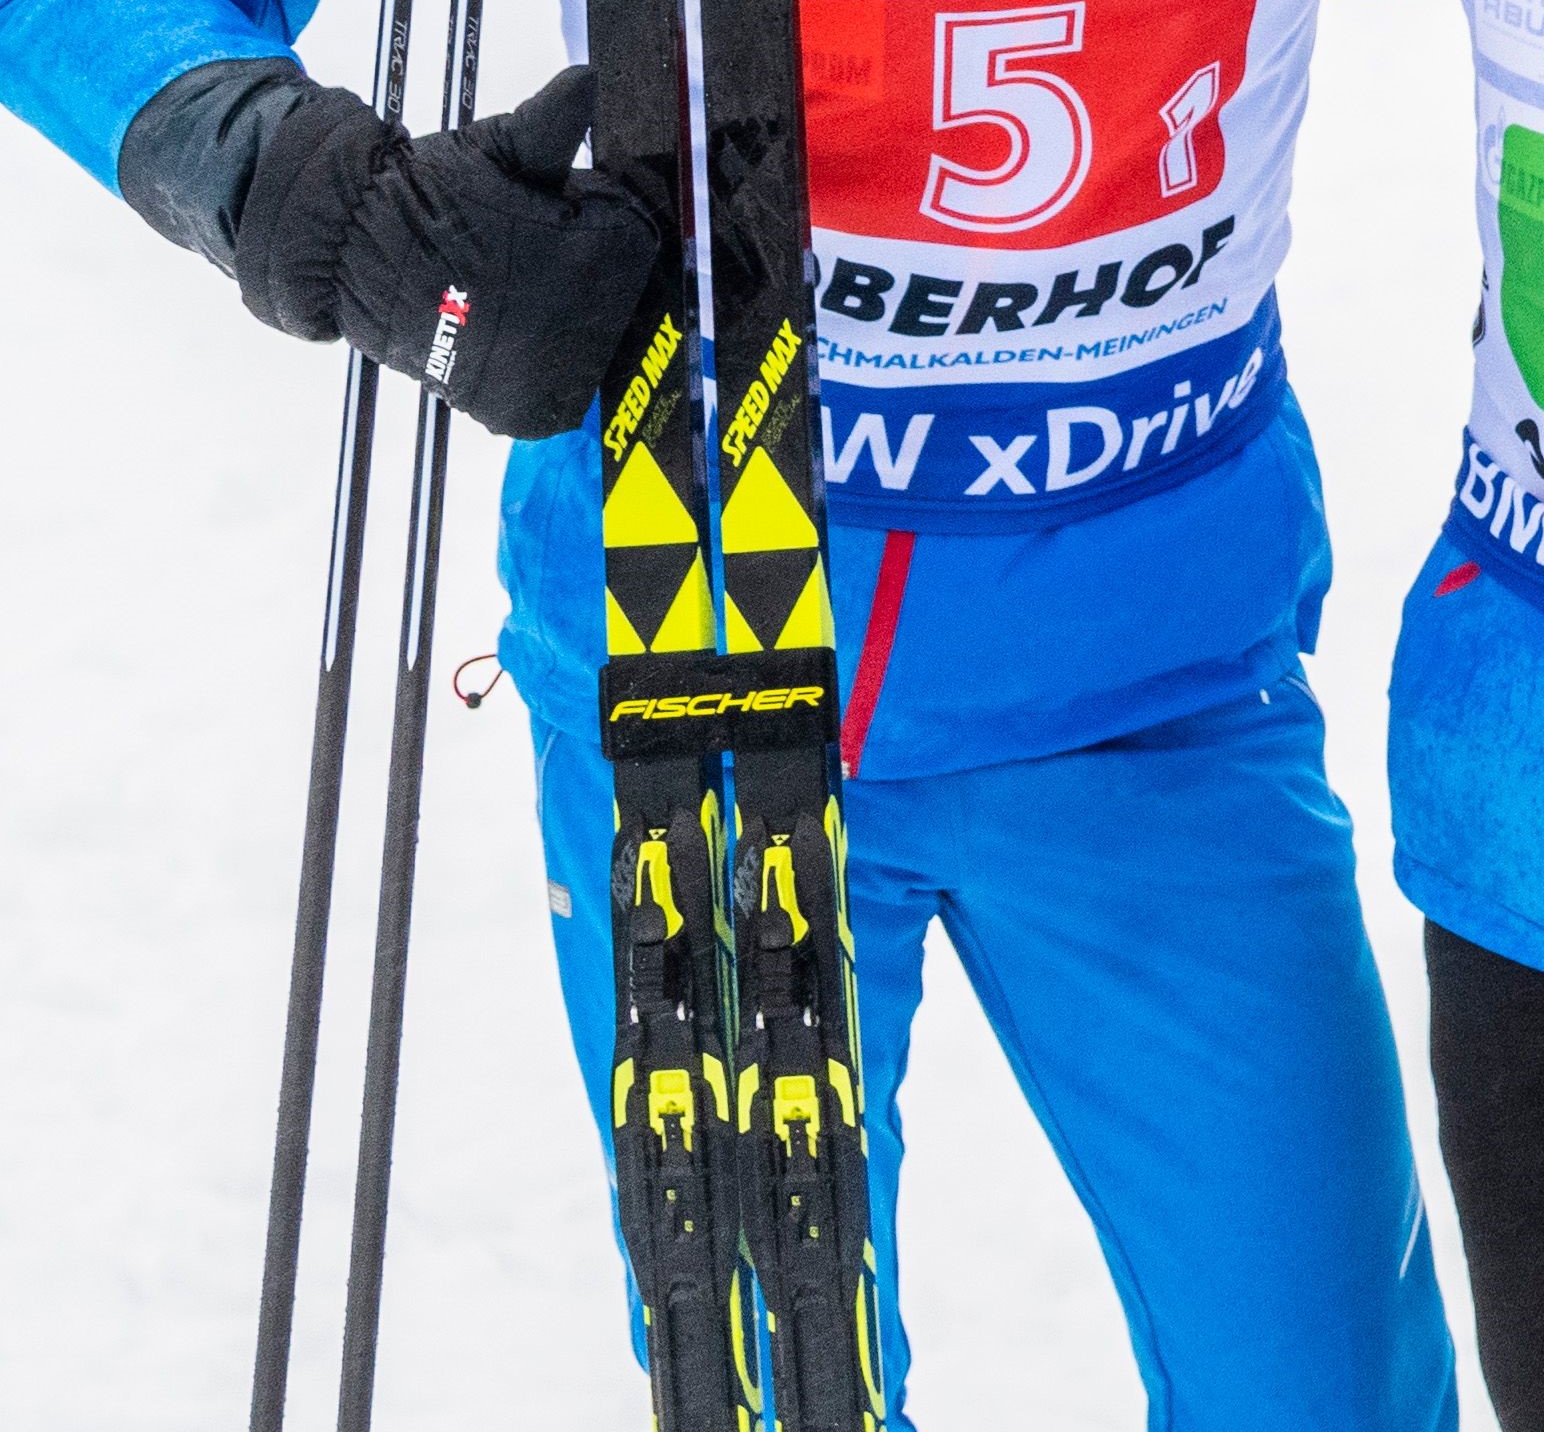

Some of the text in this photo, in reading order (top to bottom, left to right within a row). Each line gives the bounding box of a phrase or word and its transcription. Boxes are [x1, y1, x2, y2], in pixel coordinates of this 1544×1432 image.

[919, 1, 1093, 233] 5
[812, 215, 1236, 337] BERHOF
[816, 298, 1229, 368] CHMALKALDEN-MEININGEN
[603, 375, 650, 463] SPEED
[641, 312, 683, 390] MAX
[722, 380, 770, 468] SPEED
[759, 317, 802, 395] MAX
[964, 348, 1264, 496] xDrive
[610, 686, 825, 722] FISCHER
